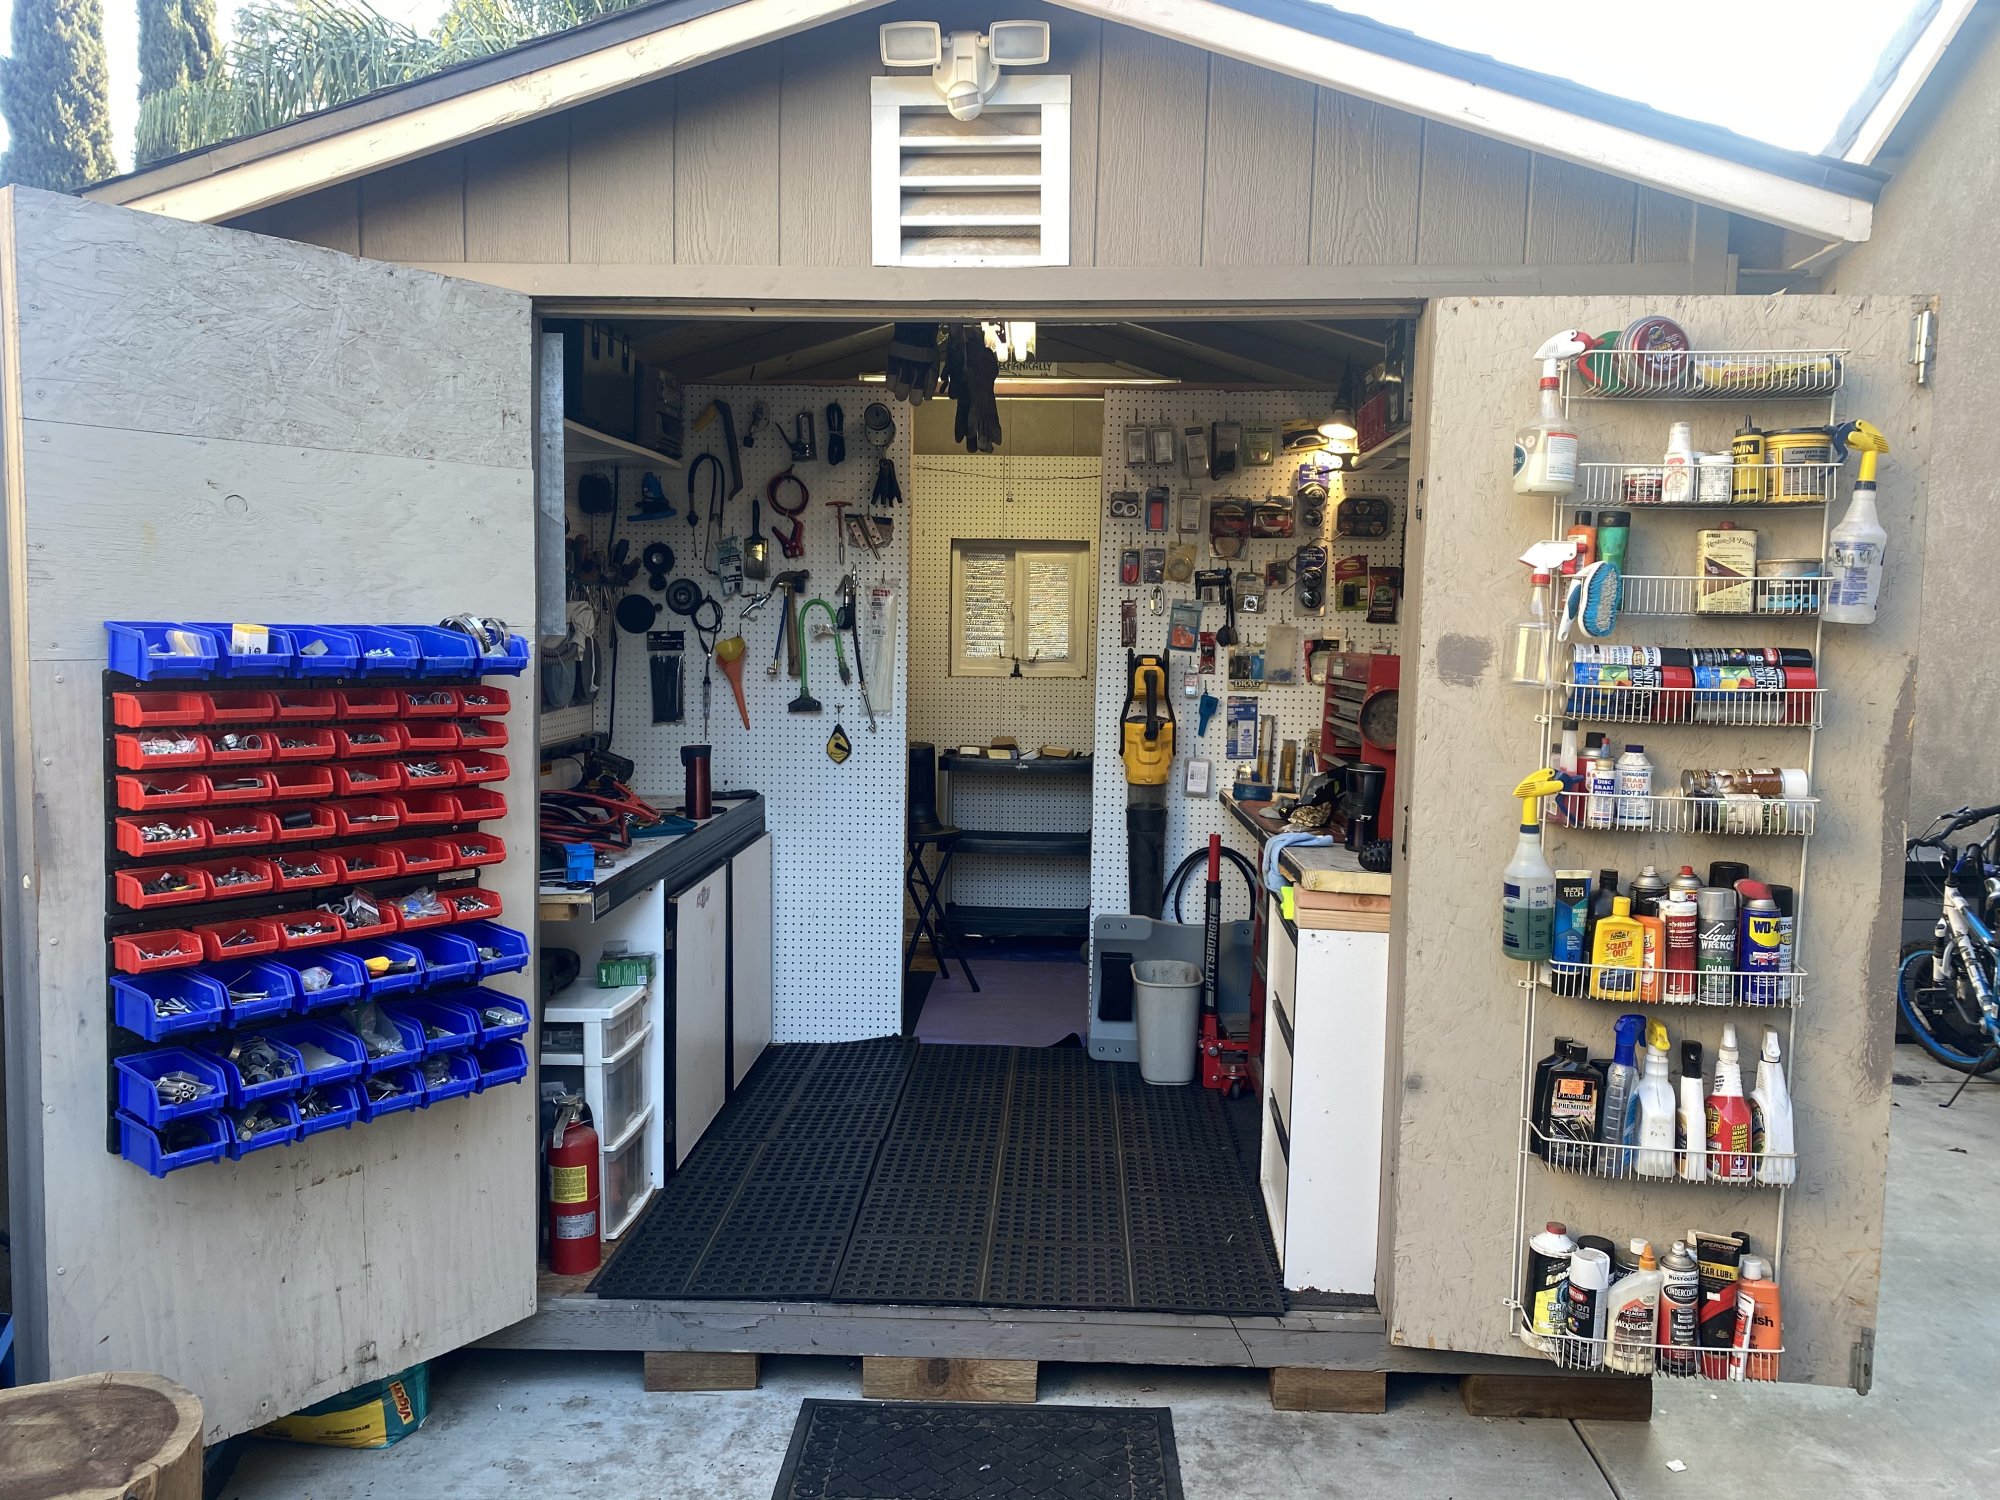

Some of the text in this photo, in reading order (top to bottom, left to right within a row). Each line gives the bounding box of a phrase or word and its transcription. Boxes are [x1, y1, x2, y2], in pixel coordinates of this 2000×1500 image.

[999, 361, 1051, 371] ECHANICALLY
[1766, 364, 1815, 381] GREASE
[1753, 920, 1780, 934] WD-4
[1699, 922, 1736, 945] Liquid
[1605, 940, 1633, 951] SCRATCH
[1701, 939, 1735, 951] WRENCH
[1205, 913, 1218, 990] PITTSBURGH
[1612, 948, 1628, 958] OUT
[1705, 964, 1731, 972] CHAIN
[1557, 1092, 1592, 1101] FLAGSHIP
[1558, 1102, 1590, 1111] PREMIUM
[1702, 1241, 1738, 1252] MERCURY
[1716, 1269, 1734, 1280] LUBE
[1547, 1302, 1567, 1311] BRA
[1752, 1315, 1774, 1328] ish
